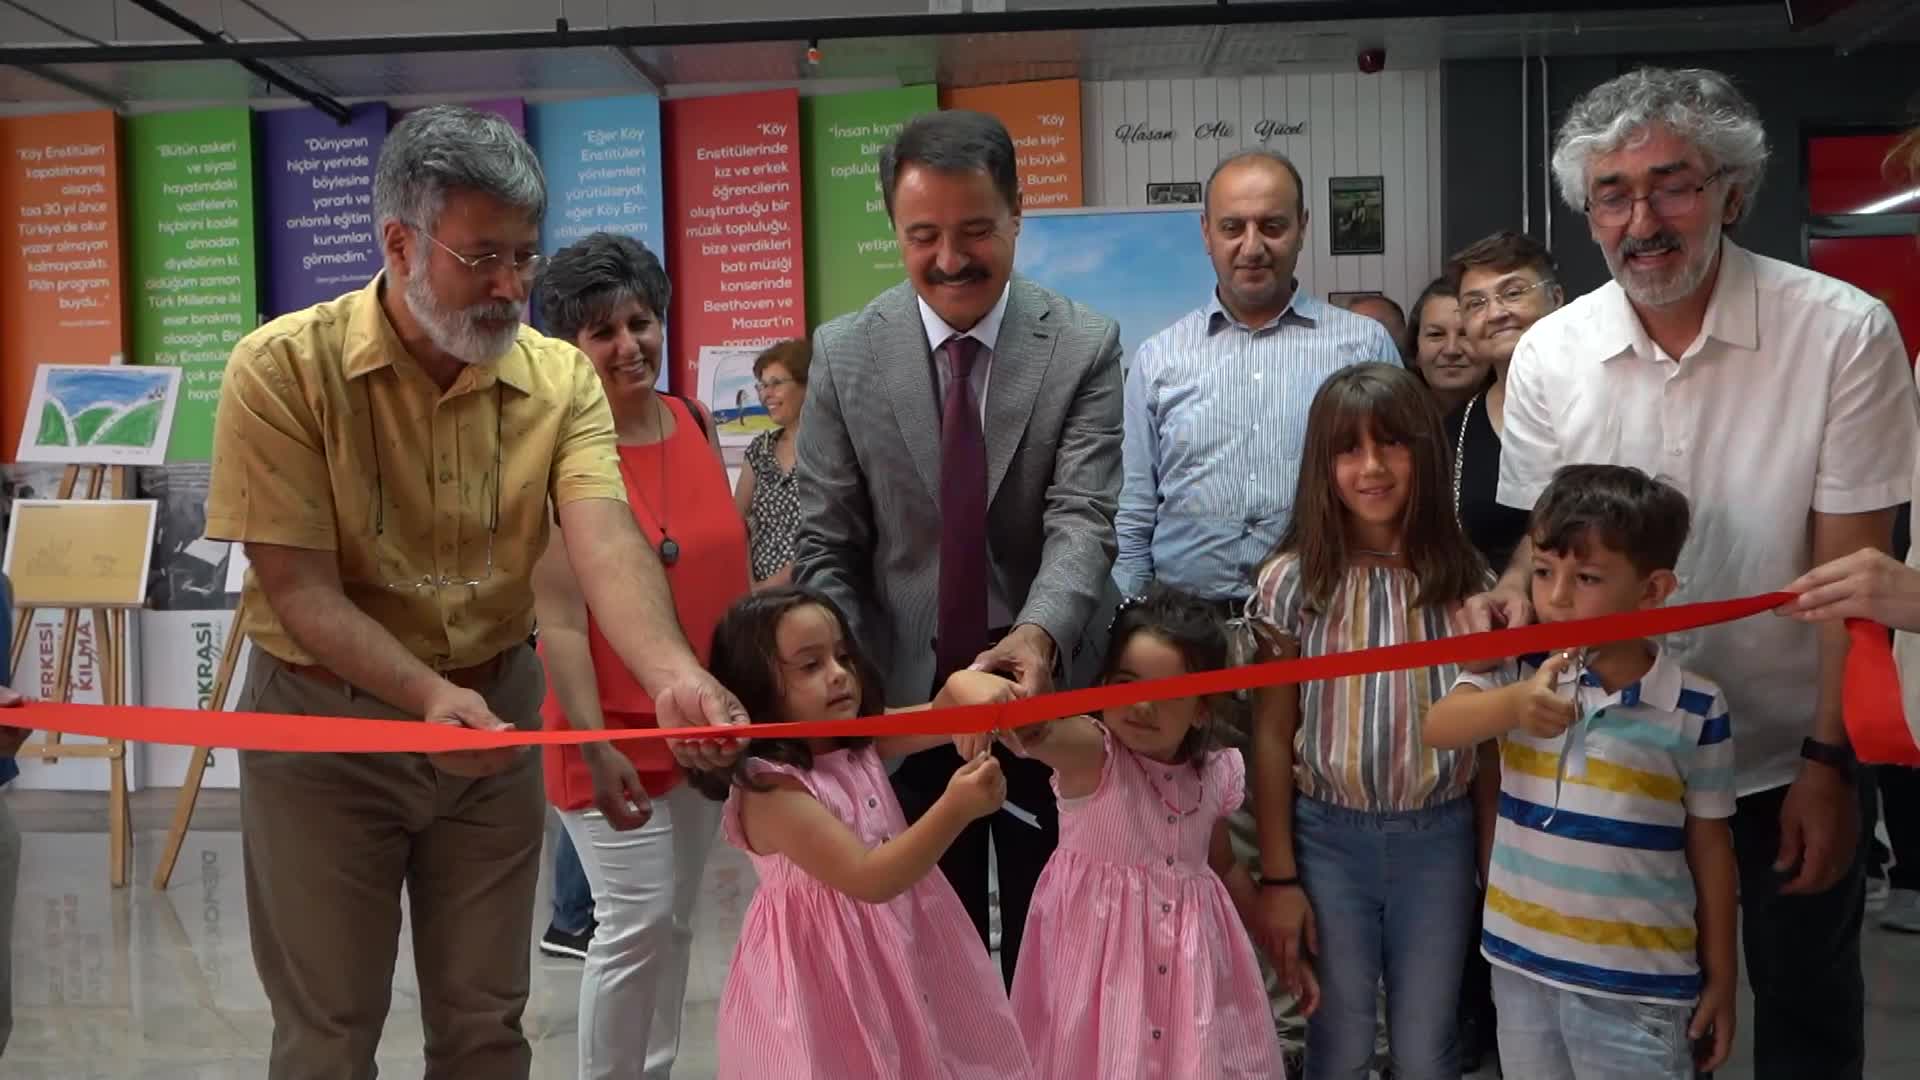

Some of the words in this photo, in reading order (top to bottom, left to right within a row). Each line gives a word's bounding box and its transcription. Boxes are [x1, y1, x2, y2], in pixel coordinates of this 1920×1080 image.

[621, 126, 645, 142] Köy
[1115, 123, 1174, 144] Hasan
[1254, 118, 1306, 143] Yücel
[581, 144, 645, 161] Enstitüleri
[696, 142, 789, 161] Enstitülerinde
[1028, 151, 1066, 168] büyük
[286, 157, 321, 174] hiçbir
[323, 154, 369, 171] yerinde
[714, 166, 732, 178] kız
[734, 166, 751, 177] ve
[752, 161, 789, 175] erkek
[312, 173, 370, 191] böylesine
[1027, 174, 1067, 185] Bunun
[712, 181, 790, 201] öğrencilerin
[312, 193, 354, 211] yararlı
[355, 193, 371, 205] ve
[690, 201, 769, 219] oluşturduğu
[771, 200, 791, 212] bir
[286, 214, 331, 229] anlamlı
[333, 211, 371, 230] eğitim
[565, 206, 593, 222] eğer
[596, 203, 621, 217] Köy
[686, 223, 722, 238] müzik
[702, 244, 729, 256] bize
[731, 239, 791, 253] verdikleri
[720, 261, 747, 274] batı
[749, 257, 792, 273] müziği
[57, 277, 110, 293] program
[199, 274, 240, 287] zaman
[720, 276, 793, 292] konserinde
[703, 298, 775, 313] Beethoven
[777, 300, 793, 309] ve
[77, 620, 93, 692] KILMA
